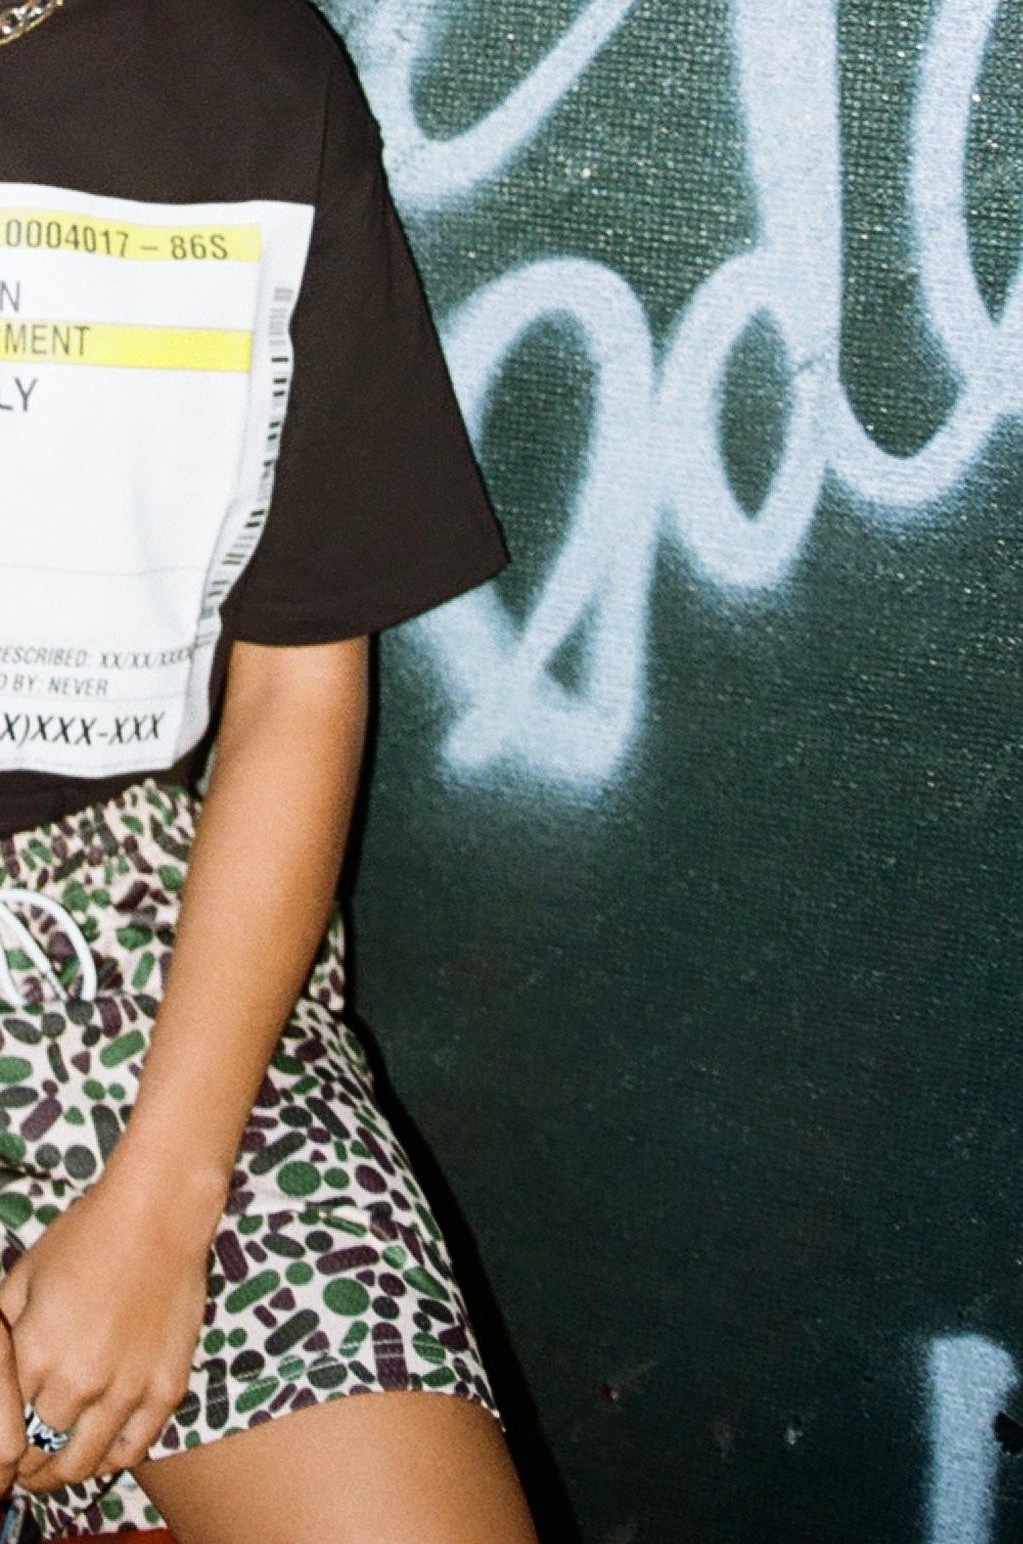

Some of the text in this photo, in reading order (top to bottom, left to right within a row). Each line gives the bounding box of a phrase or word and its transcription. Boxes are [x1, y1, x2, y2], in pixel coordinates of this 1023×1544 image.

[5, 218, 129, 258] 0004017
[170, 233, 229, 260] 86S
[47, 676, 109, 697] NEVER
